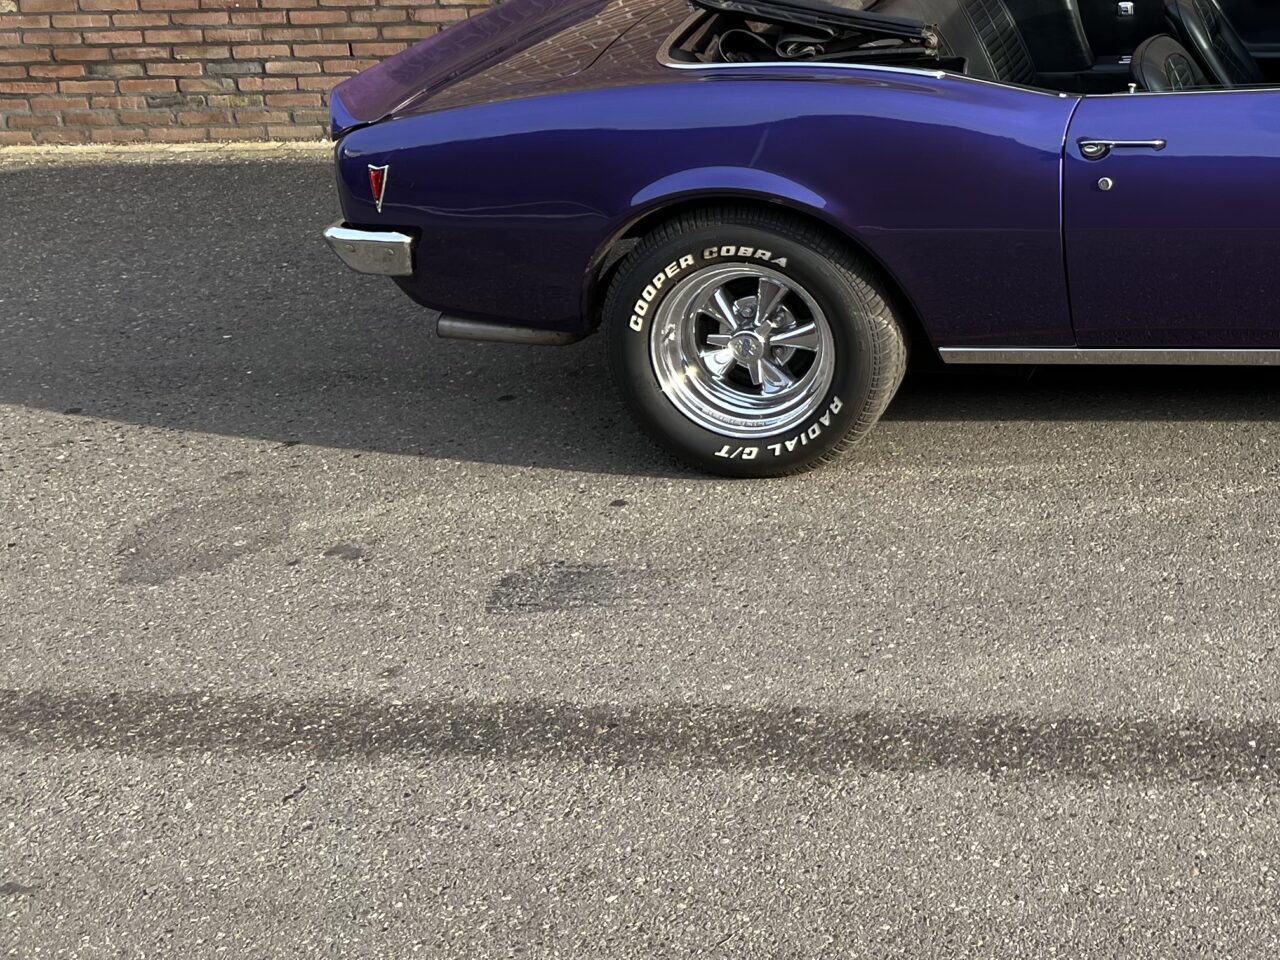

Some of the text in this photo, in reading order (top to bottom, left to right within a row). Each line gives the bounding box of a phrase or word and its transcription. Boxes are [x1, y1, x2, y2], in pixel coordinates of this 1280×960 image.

[629, 245, 788, 332] COOPER COBRA
[714, 395, 844, 460] RADIAL G/T
